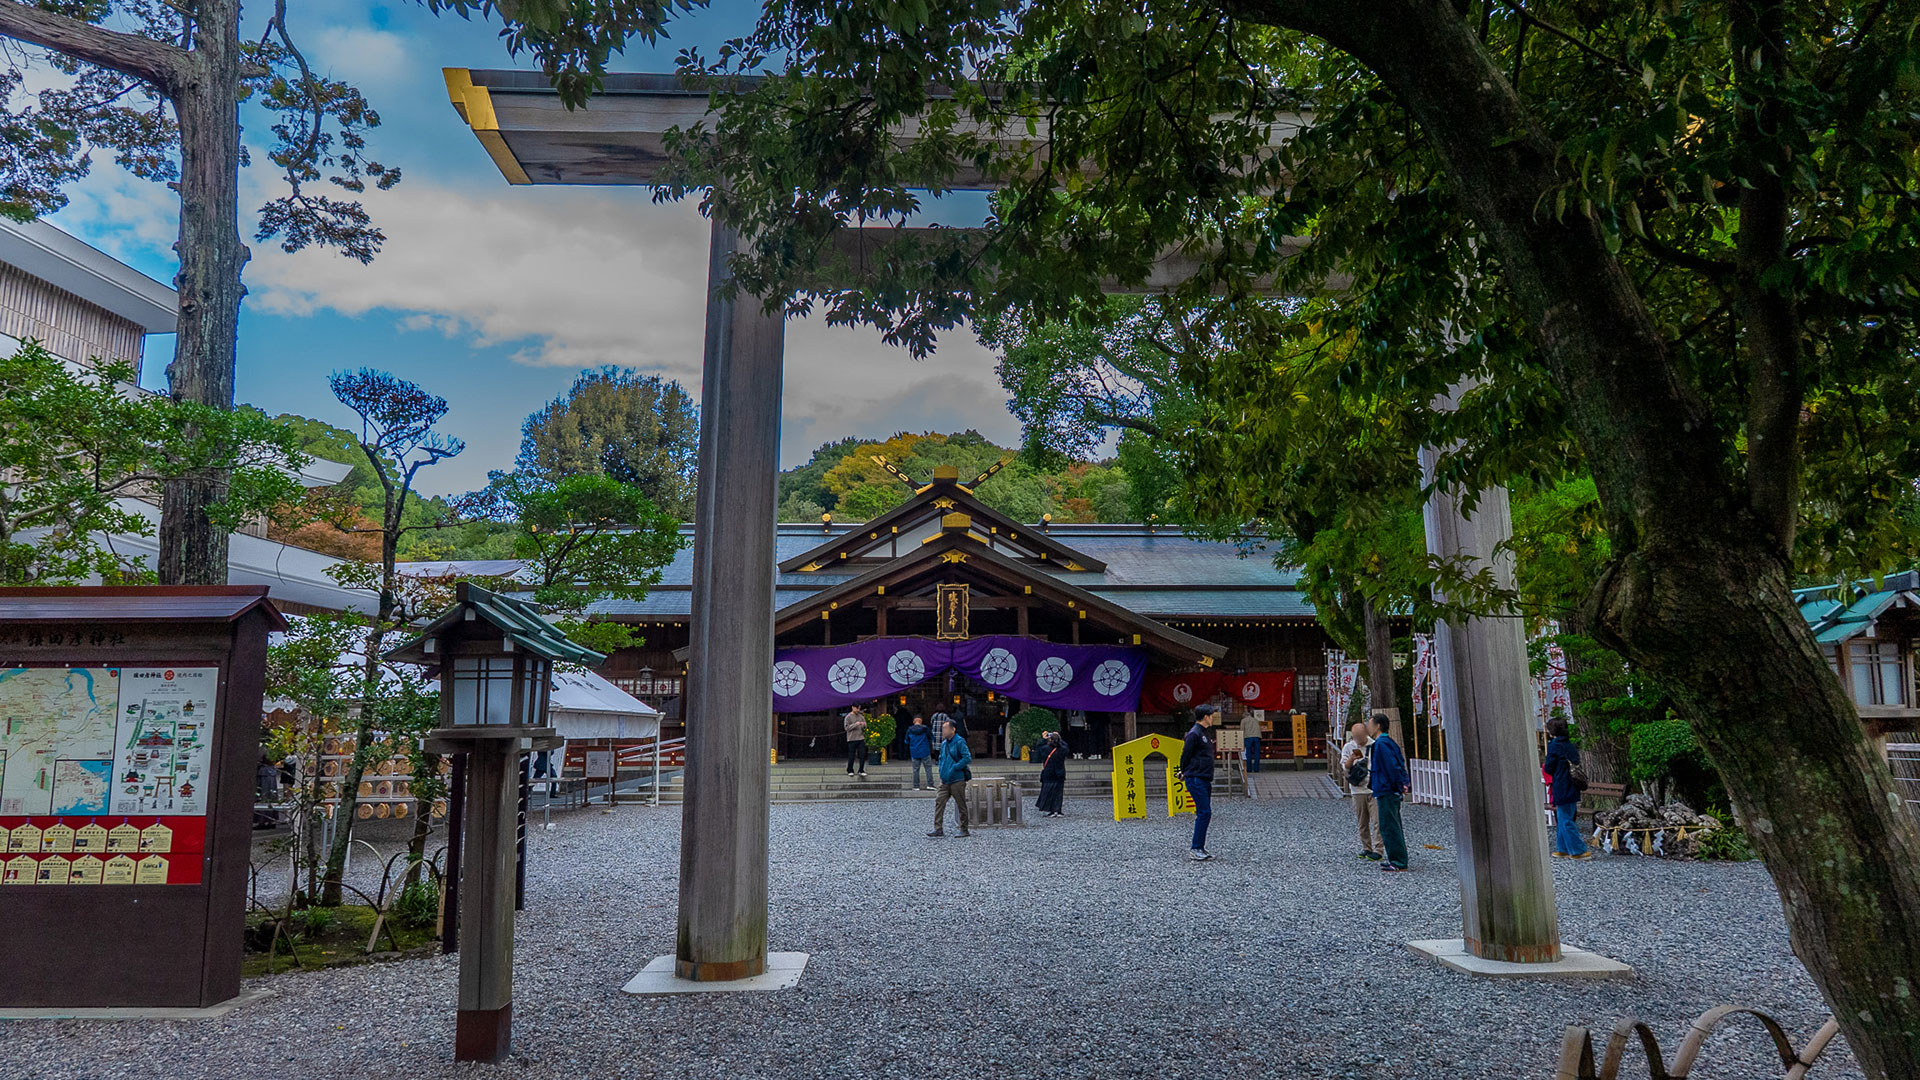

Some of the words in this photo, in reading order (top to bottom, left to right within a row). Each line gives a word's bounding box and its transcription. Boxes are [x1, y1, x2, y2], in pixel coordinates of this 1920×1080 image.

[1125, 754, 1137, 814] 猿田彦神社
